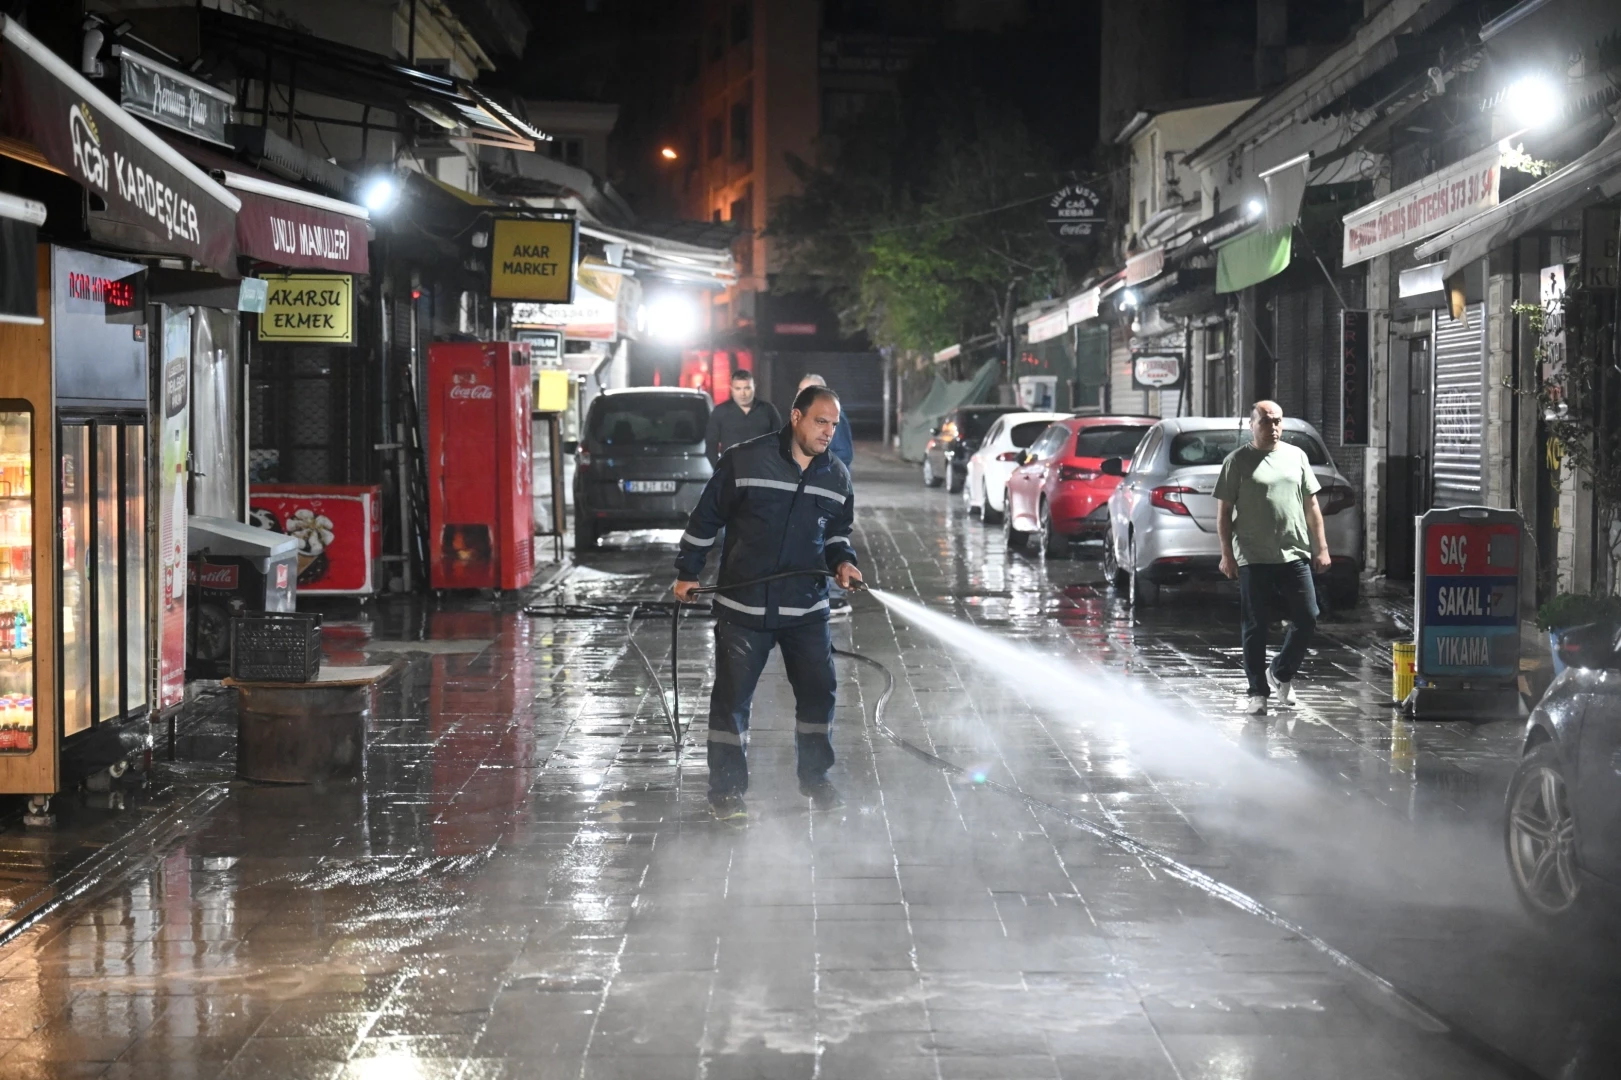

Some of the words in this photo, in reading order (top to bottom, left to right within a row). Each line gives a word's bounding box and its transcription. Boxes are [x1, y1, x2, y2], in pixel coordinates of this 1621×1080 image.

[70, 104, 109, 191] Acar
[114, 152, 200, 244] KARDEŞLER
[1407, 180, 1450, 230] KÖFTECİSİ
[270, 216, 296, 254] UNLU
[513, 245, 550, 258] AKAR
[503, 261, 558, 276] MARKET
[268, 289, 341, 306] AKARSU
[273, 312, 335, 329] EKMEK
[450, 385, 493, 399] Coca-Cola
[1440, 535, 1468, 573] SAÇ
[1438, 586, 1483, 616] SAKAL
[1436, 637, 1490, 666] YIKAMA
